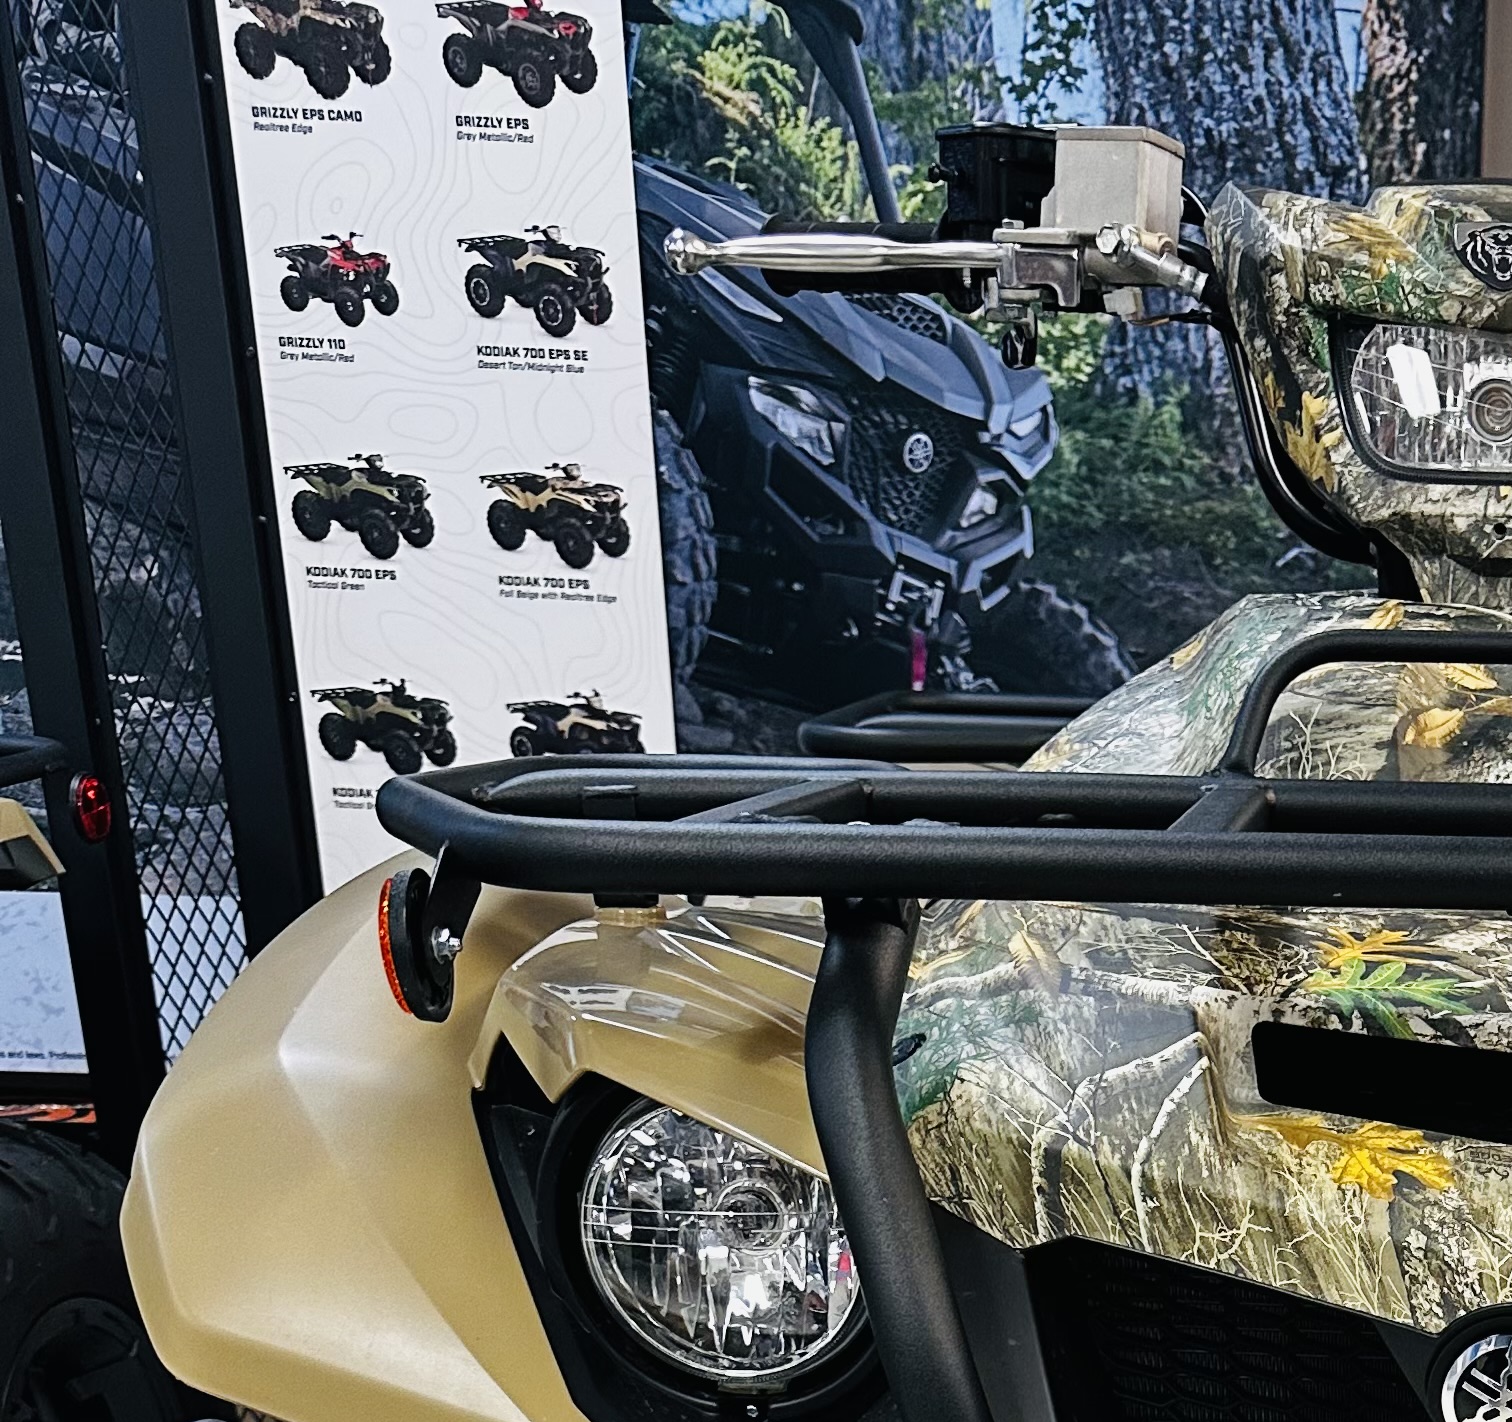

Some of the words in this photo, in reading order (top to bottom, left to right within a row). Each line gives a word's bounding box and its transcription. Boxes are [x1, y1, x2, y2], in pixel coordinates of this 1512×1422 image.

[251, 106, 298, 119] GRIZZLY
[302, 108, 325, 120] EPS
[327, 110, 362, 122] CAMO
[253, 122, 289, 132] Realtree
[291, 123, 313, 134] Edge
[455, 115, 503, 128] GRIZZLY
[506, 118, 529, 129] EPS
[278, 336, 324, 349] GRIZZLY
[327, 338, 346, 349] 110
[477, 345, 520, 357] KODIAK
[522, 347, 546, 359] 700
[548, 349, 571, 360] EPS
[573, 350, 588, 361] SE
[306, 566, 348, 578] KODIAK
[350, 568, 372, 579] 700
[374, 569, 397, 580] EPS
[498, 575, 541, 587] KODIAK
[543, 577, 565, 588] 700
[567, 578, 590, 589] EPS
[332, 787, 374, 798] KODIAK
